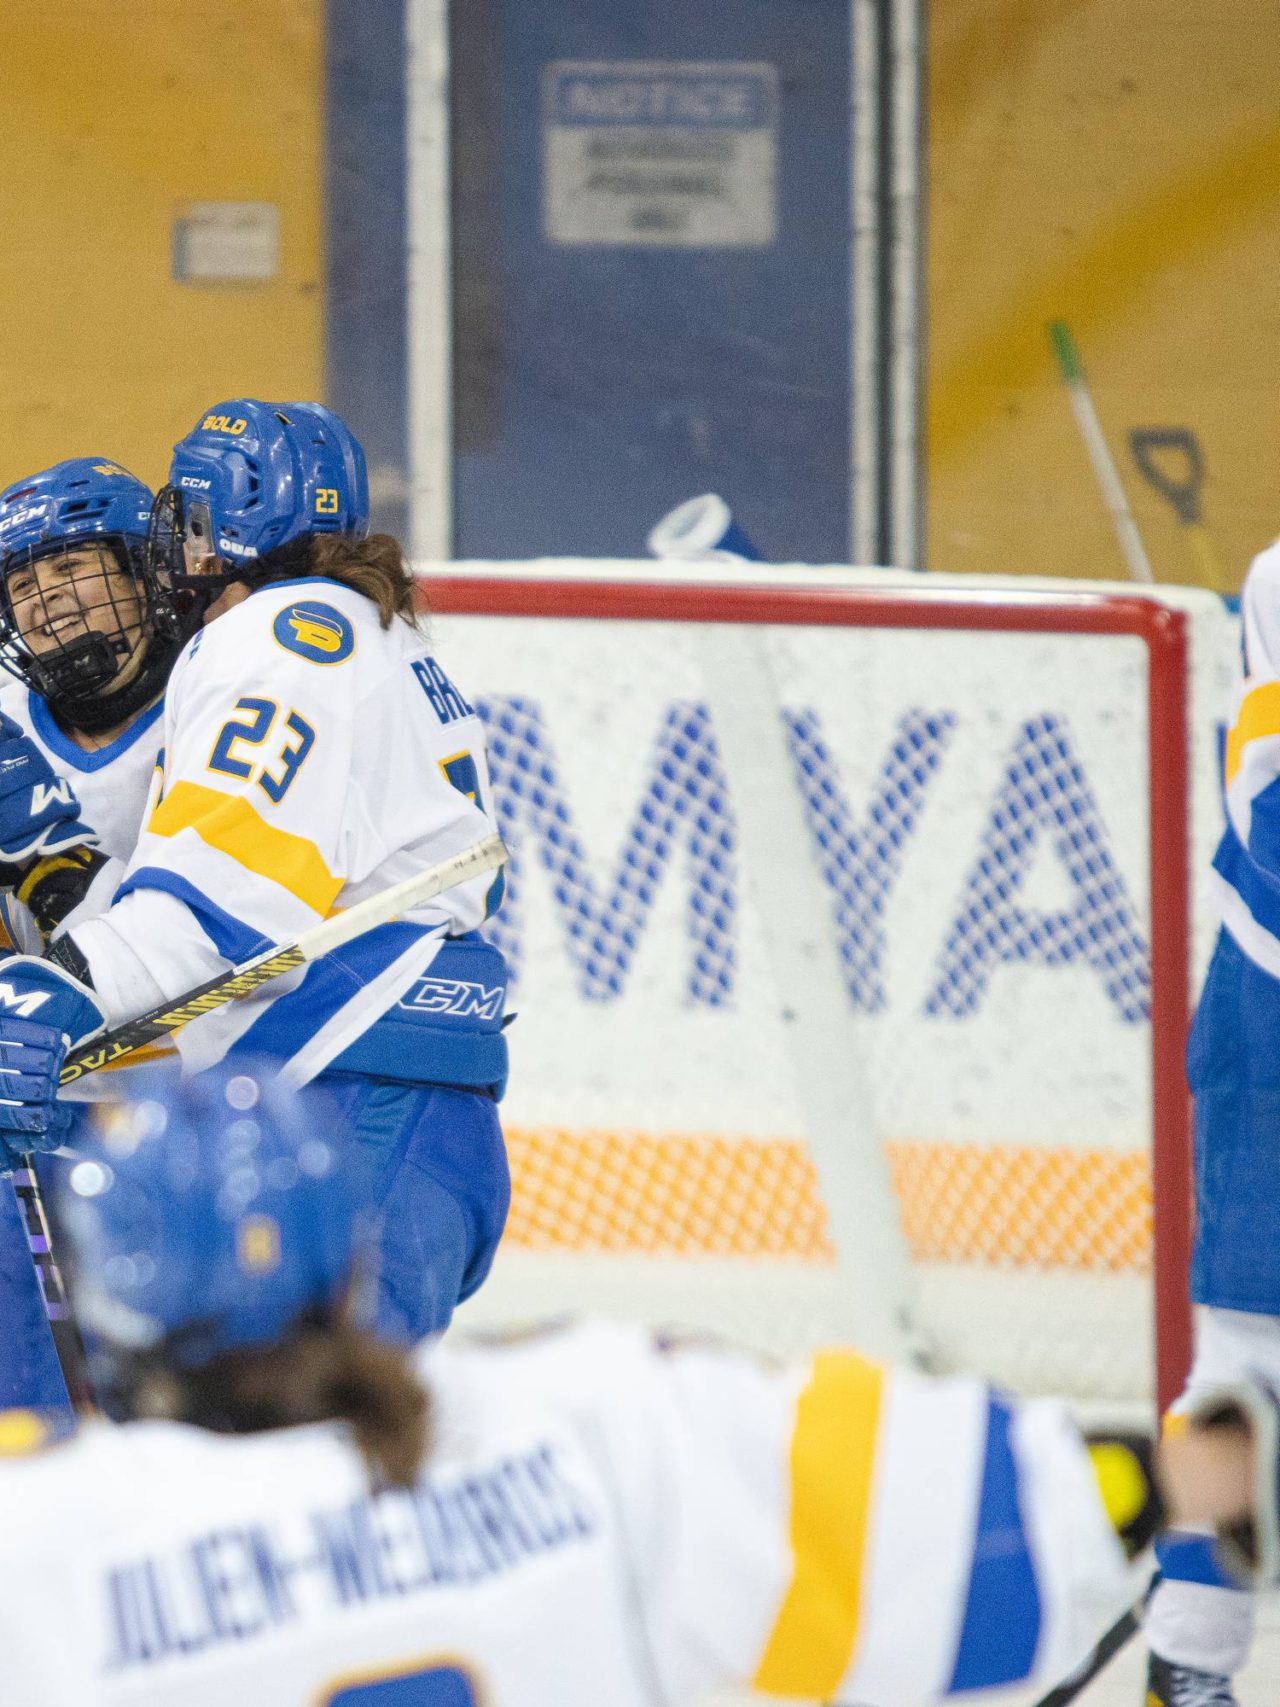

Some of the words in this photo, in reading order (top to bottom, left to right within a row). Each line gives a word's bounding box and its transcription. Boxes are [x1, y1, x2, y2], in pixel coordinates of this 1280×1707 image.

[202, 415, 247, 435] BOLD
[181, 476, 211, 490] CCM
[315, 488, 338, 513] 23
[220, 538, 259, 557] OUA
[410, 656, 476, 725] BR
[206, 694, 318, 807] 23
